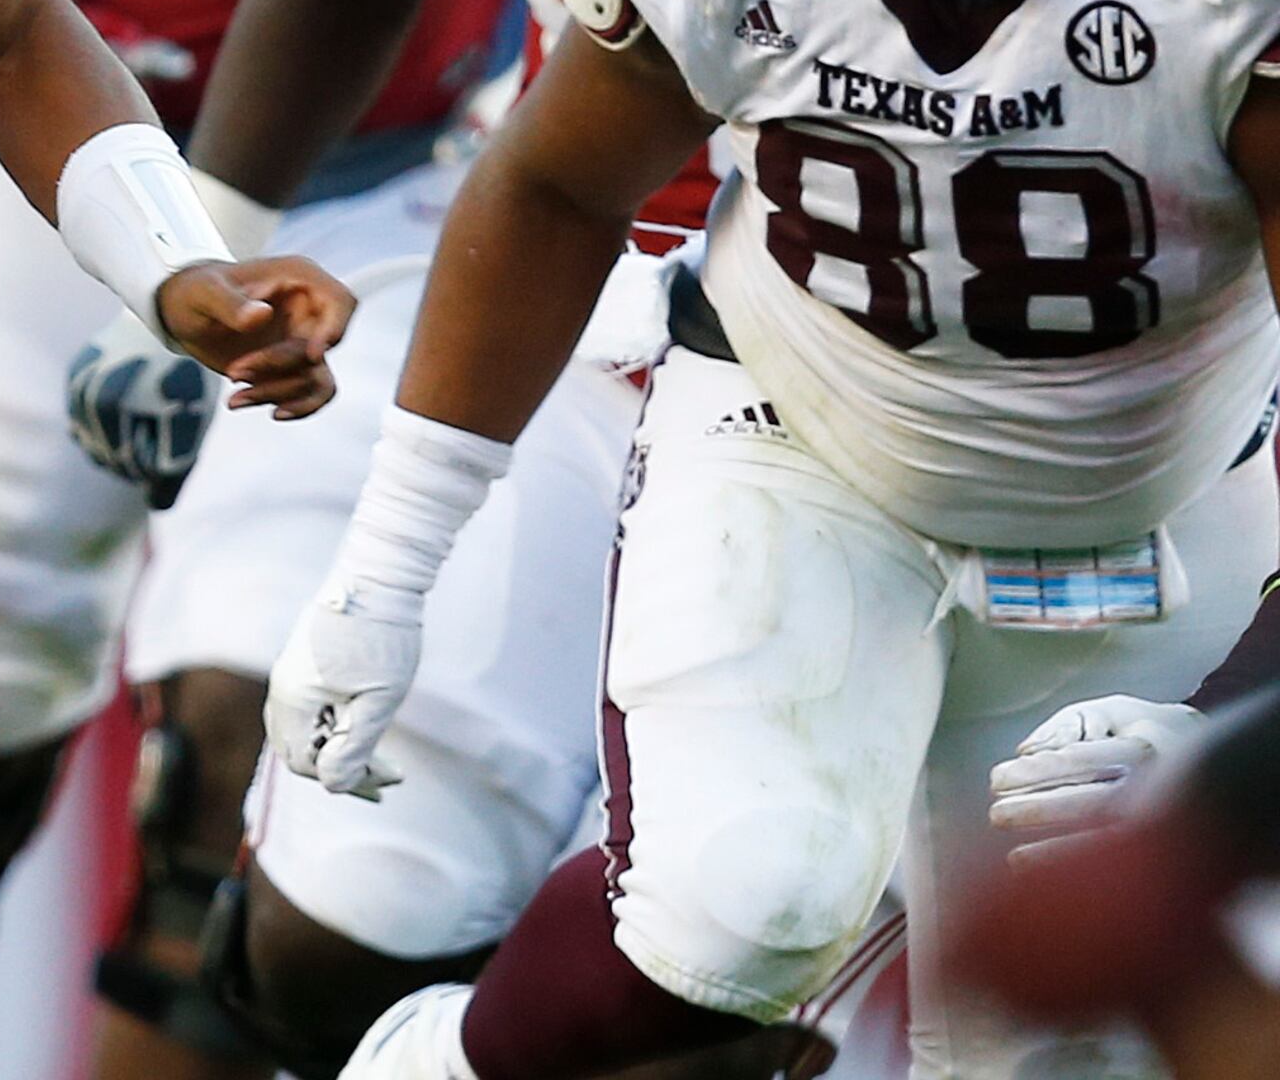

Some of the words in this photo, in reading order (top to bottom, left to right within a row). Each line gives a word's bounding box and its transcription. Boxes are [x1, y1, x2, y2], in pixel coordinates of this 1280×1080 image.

[1065, 0, 1156, 85] SEC
[813, 59, 957, 137] TEXAS
[969, 83, 1066, 137] A&M
[756, 117, 1161, 360] 88
